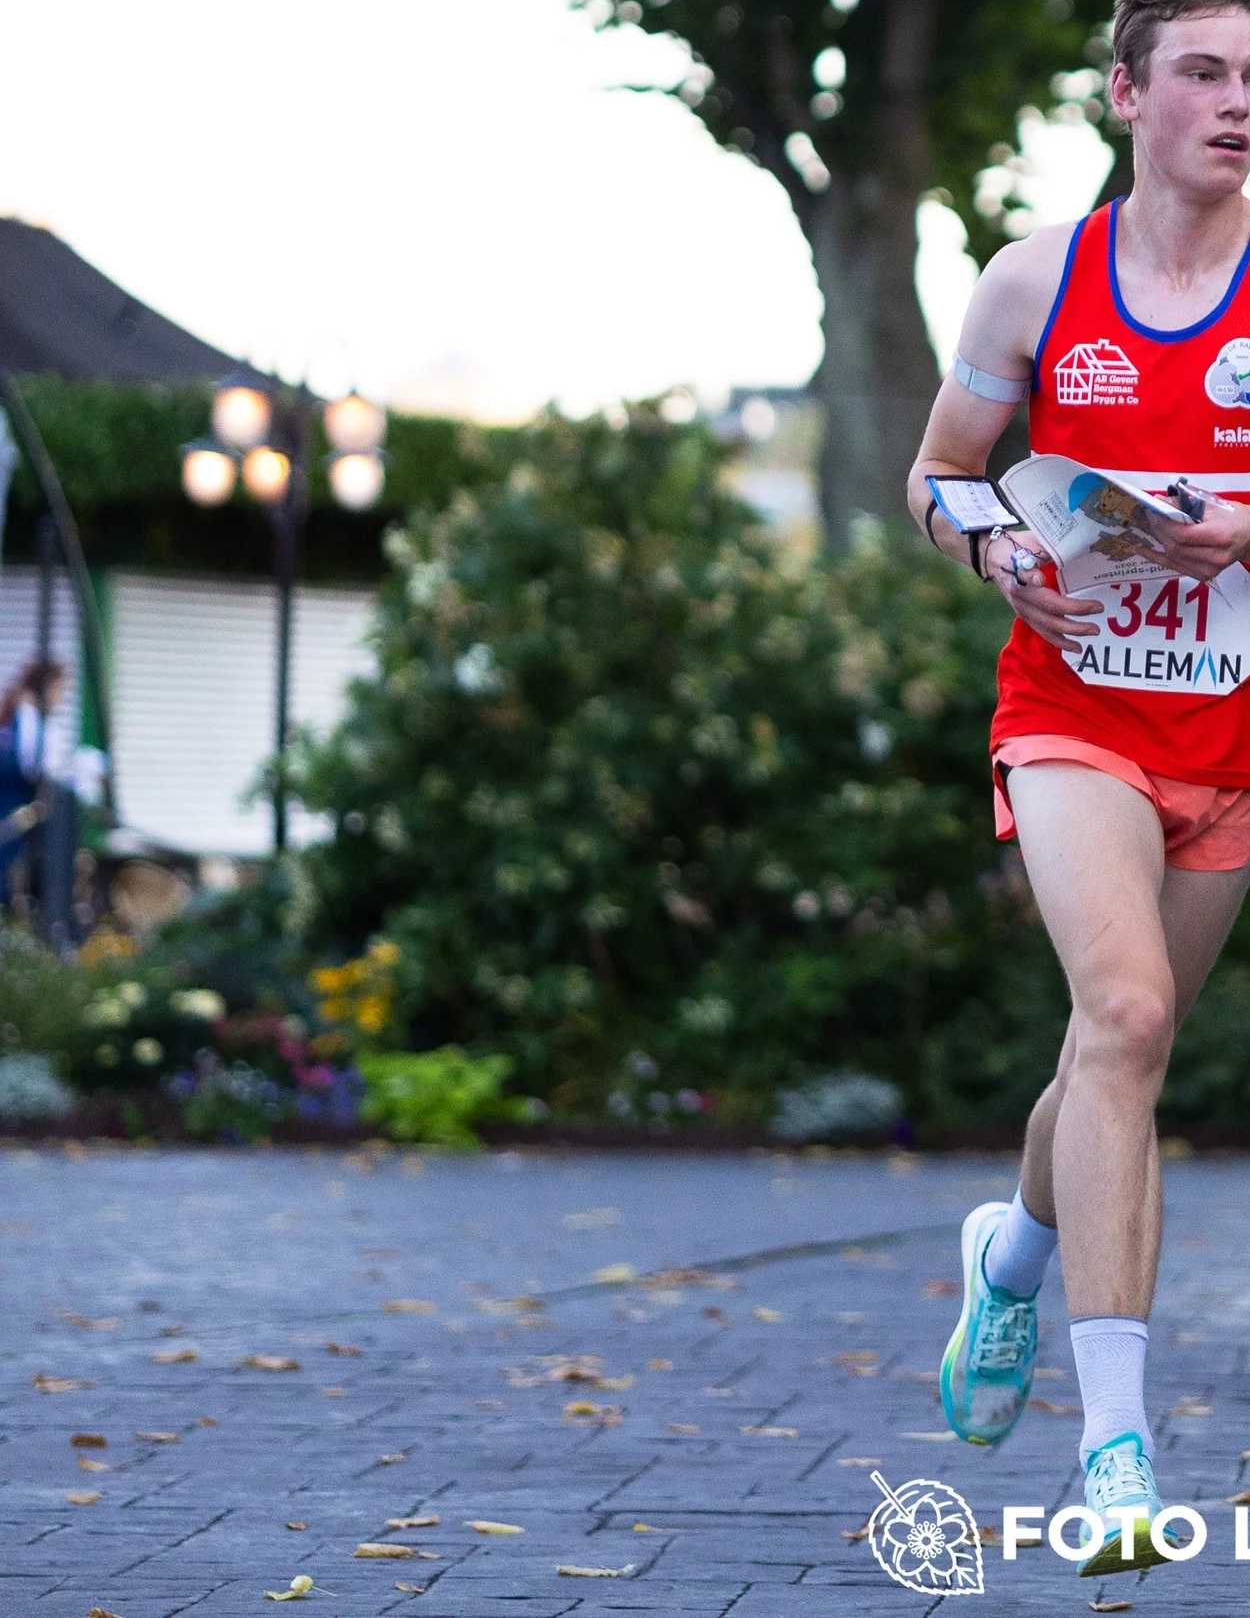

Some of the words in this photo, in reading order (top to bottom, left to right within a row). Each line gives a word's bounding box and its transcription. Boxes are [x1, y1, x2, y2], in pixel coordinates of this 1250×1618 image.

[1094, 375, 1108, 384] AB
[1092, 395, 1116, 405] Bygg
[1118, 395, 1125, 404] &
[1126, 396, 1139, 405] Co
[1107, 577, 1210, 642] 341
[1077, 644, 1242, 690] ALLEMAN
